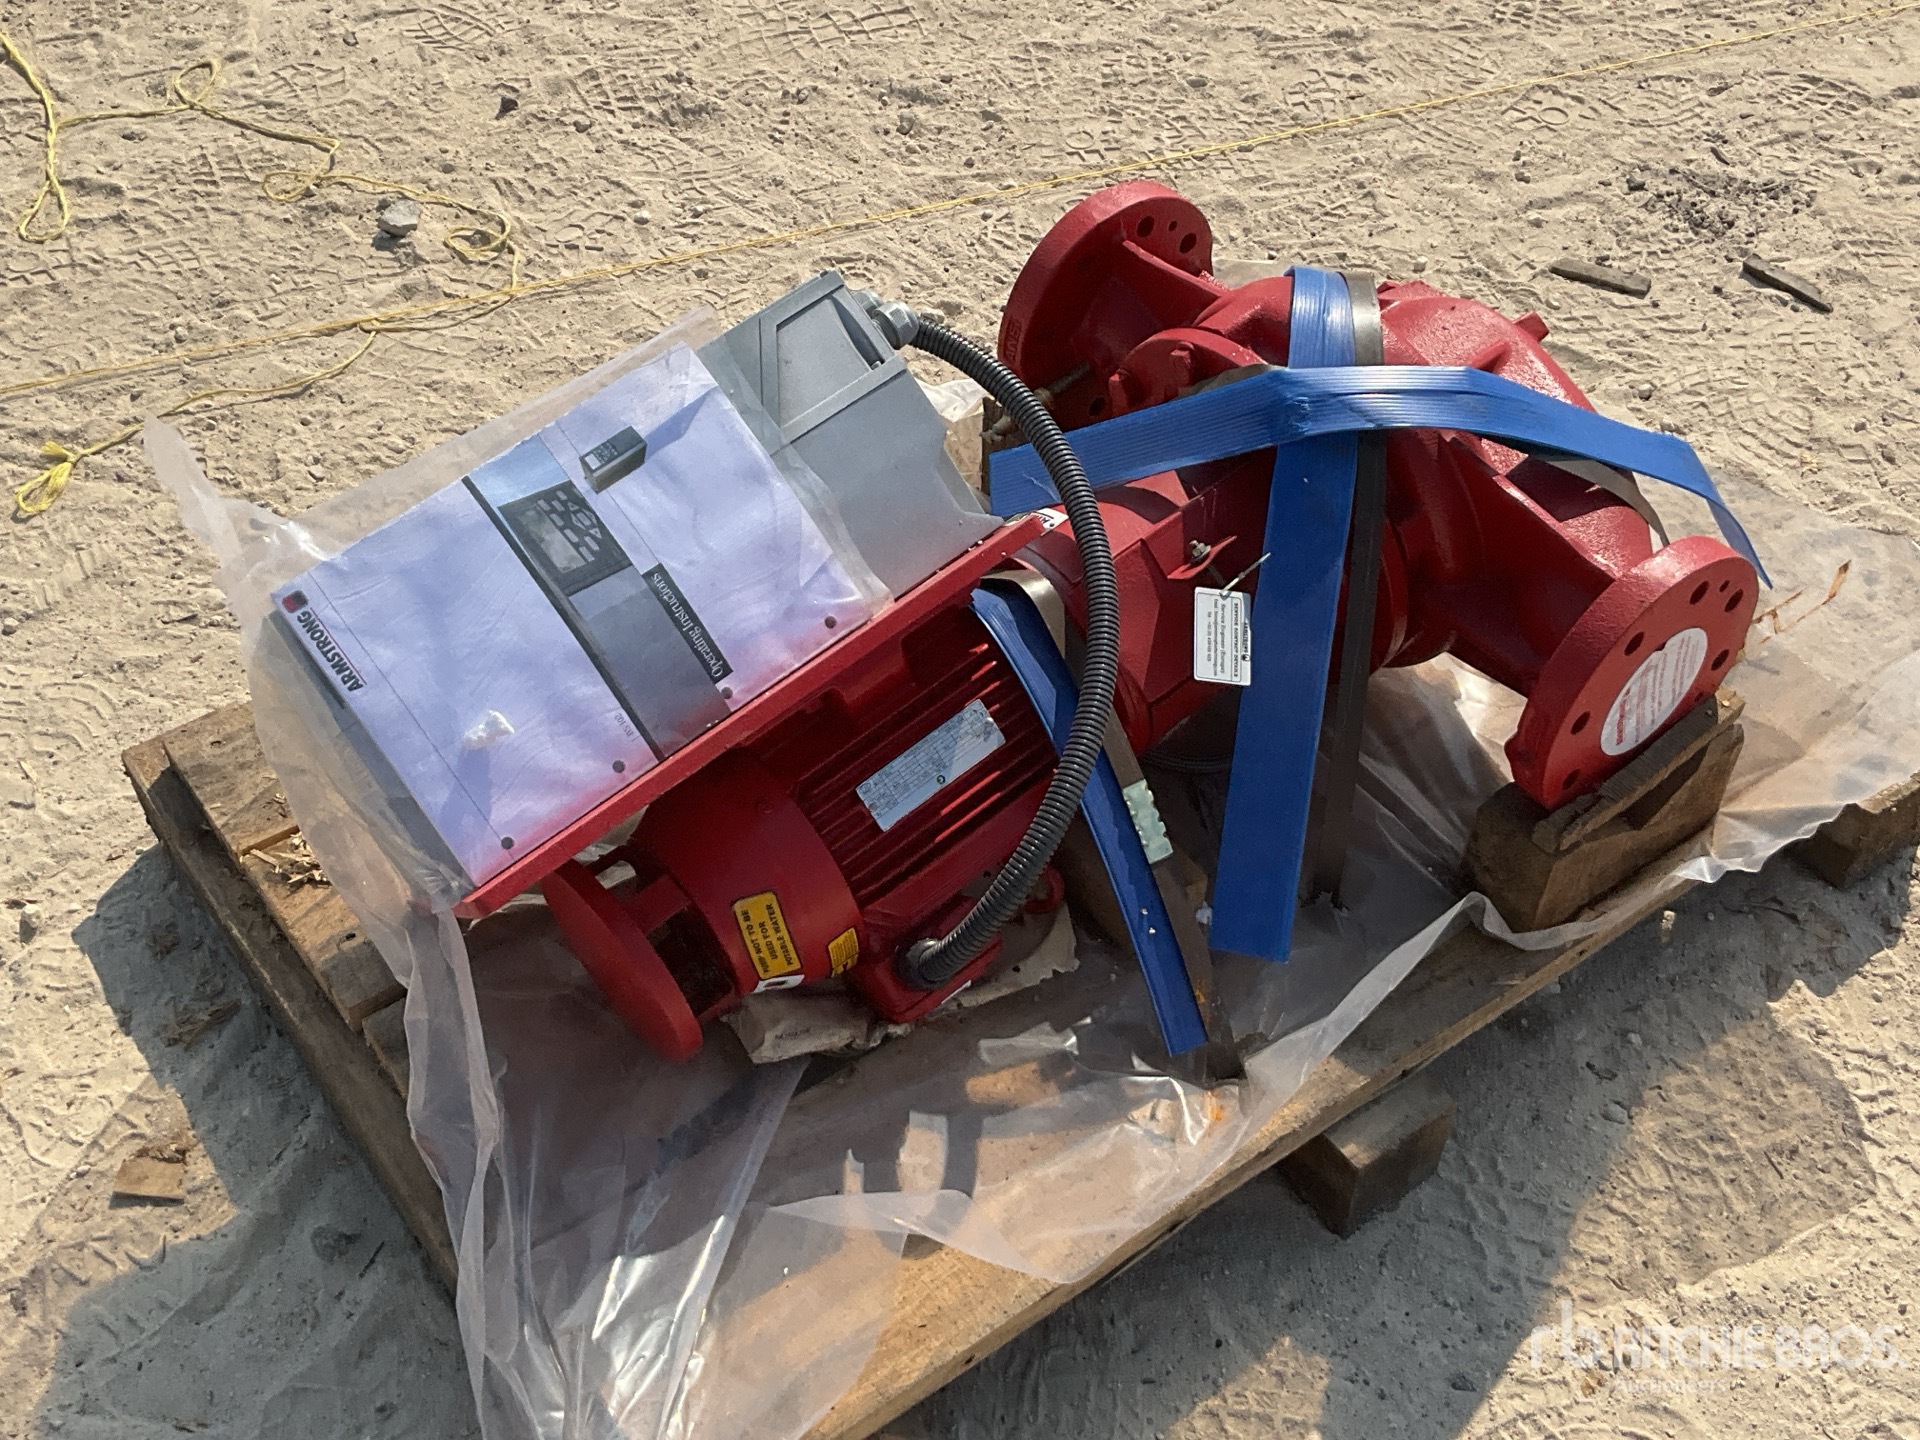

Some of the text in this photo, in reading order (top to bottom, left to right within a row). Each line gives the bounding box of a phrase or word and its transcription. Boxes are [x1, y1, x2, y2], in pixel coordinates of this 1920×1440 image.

[651, 572, 724, 678] Operating Instructions
[297, 610, 363, 692] ARMSTRONG
[741, 910, 749, 922] BE
[746, 925, 755, 935] TO
[766, 903, 793, 966] POTABLE WATER
[750, 938, 762, 954] NOT
[759, 921, 777, 960] USED FOR
